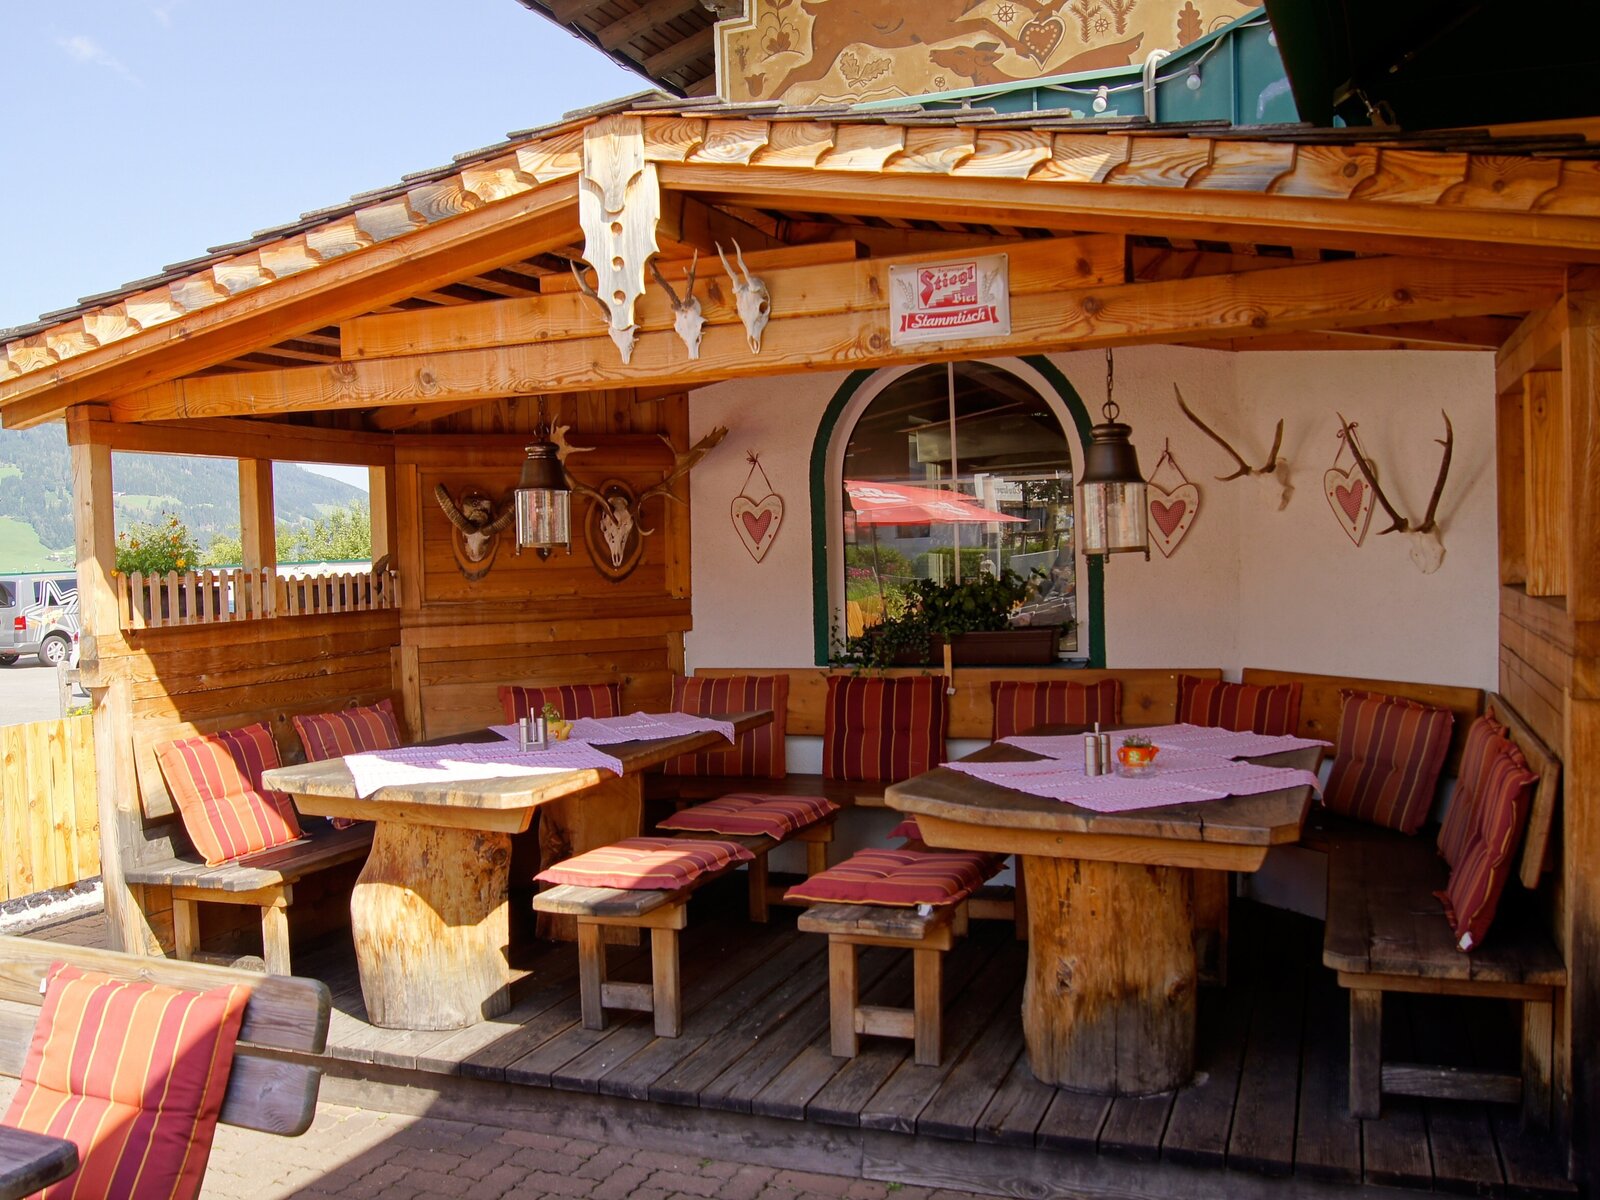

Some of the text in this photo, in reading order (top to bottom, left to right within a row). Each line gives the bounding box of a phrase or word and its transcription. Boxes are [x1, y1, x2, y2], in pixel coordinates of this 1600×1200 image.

[919, 266, 974, 307] Stiegl
[952, 292, 977, 304] Bier
[911, 307, 986, 328] Stammtisch
